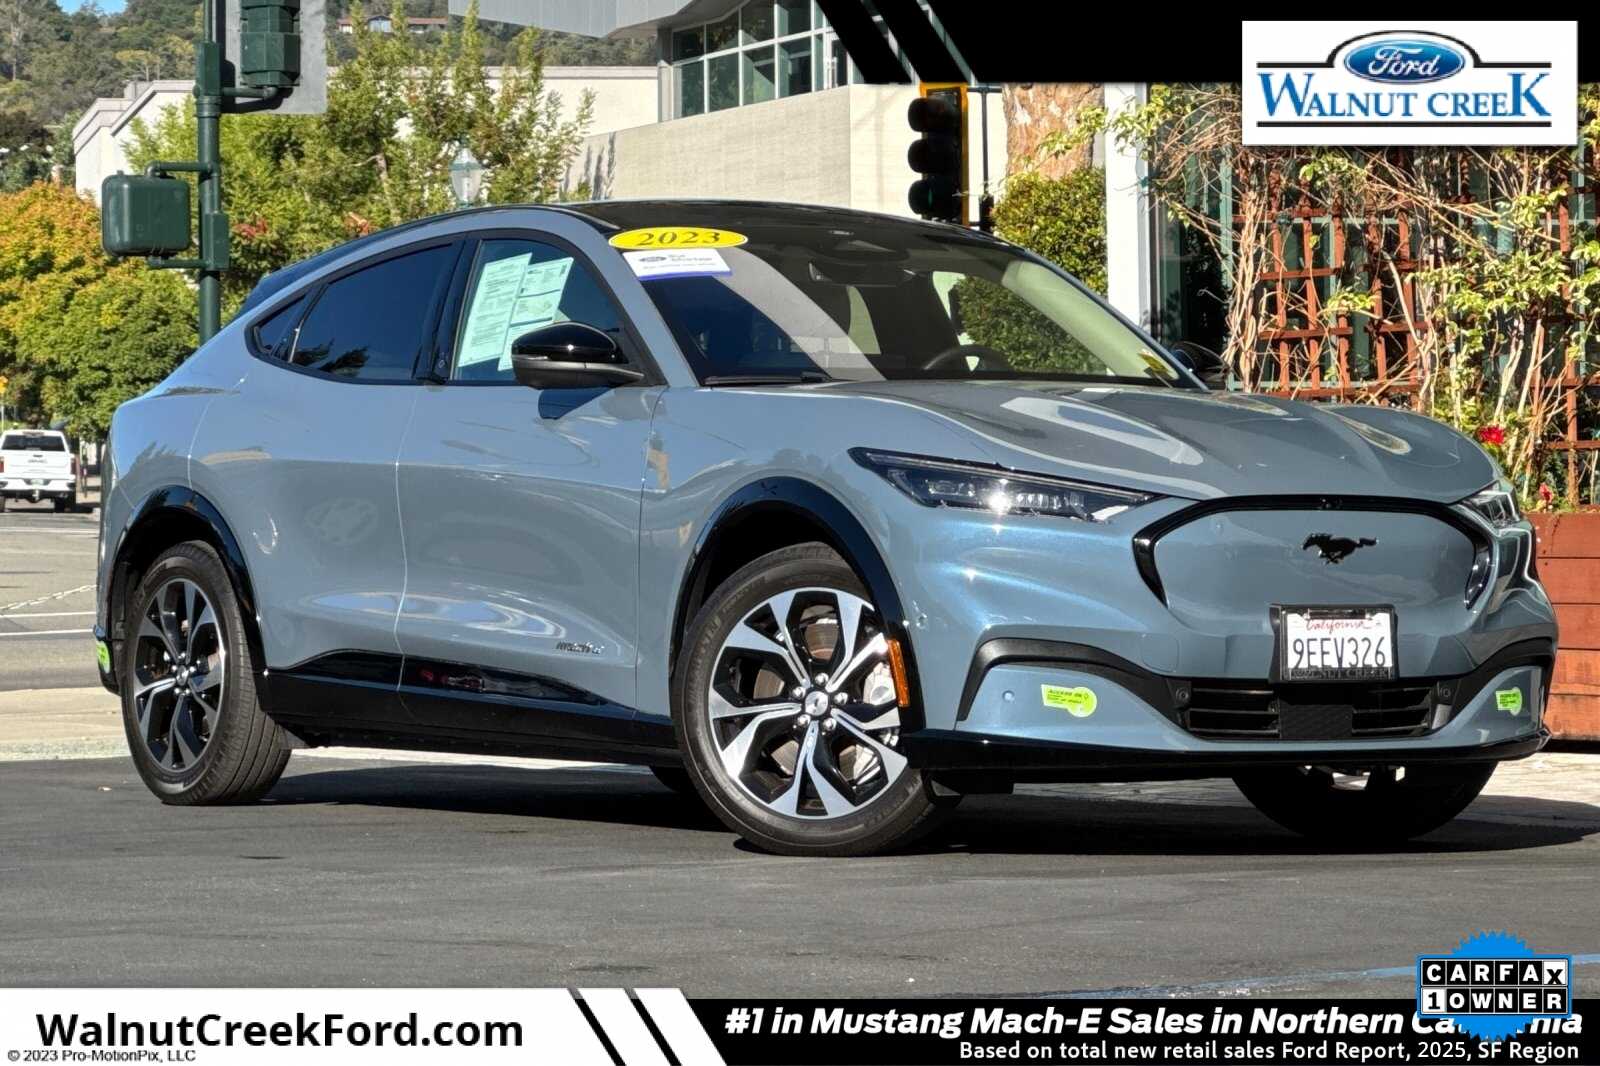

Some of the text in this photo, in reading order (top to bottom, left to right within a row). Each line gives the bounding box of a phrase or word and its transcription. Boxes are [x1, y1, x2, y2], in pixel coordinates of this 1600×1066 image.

[636, 231, 720, 246] 2023
[1306, 619, 1365, 634] California
[1292, 637, 1386, 669] 9EEV326
